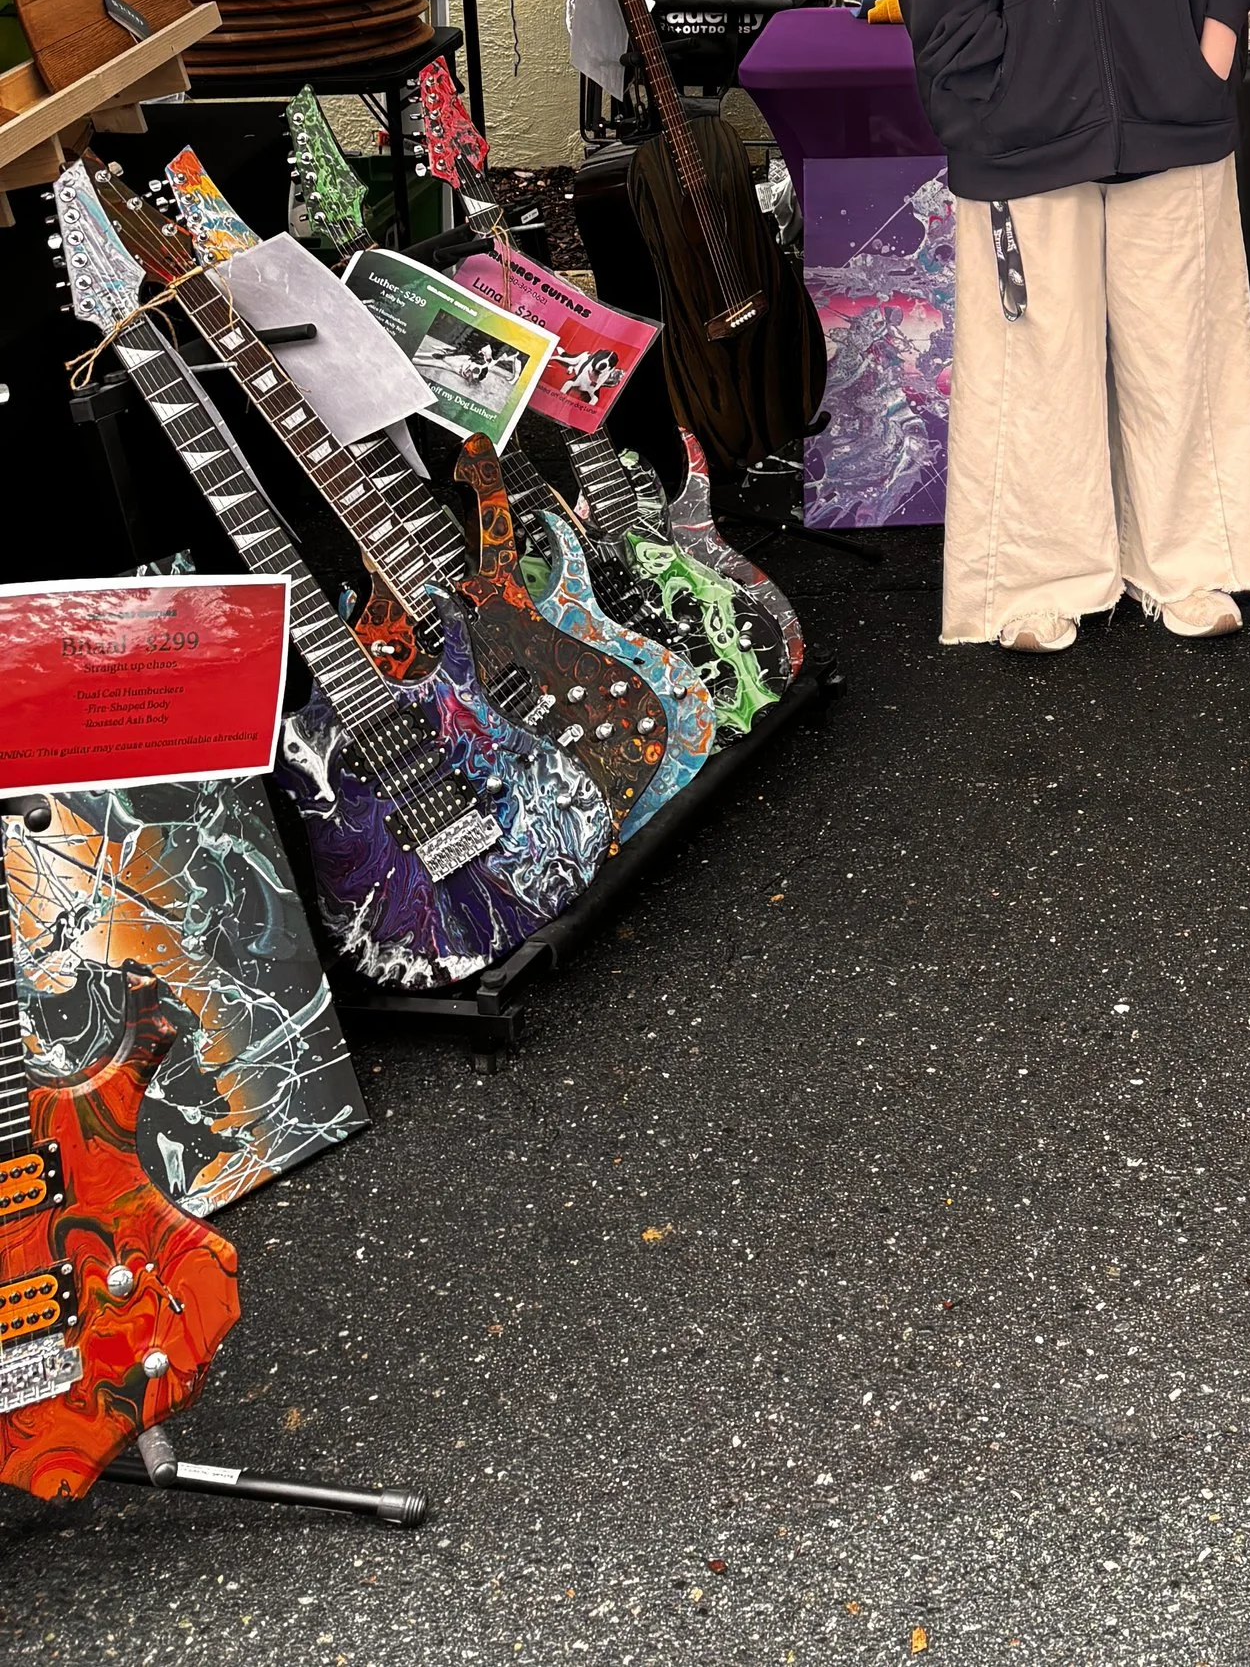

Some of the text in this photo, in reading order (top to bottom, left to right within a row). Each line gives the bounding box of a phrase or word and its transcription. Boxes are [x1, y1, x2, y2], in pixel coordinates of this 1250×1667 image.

[368, 271, 400, 293] Luther
[402, 289, 427, 308] $299
[471, 276, 505, 303] Luna
[506, 275, 550, 305] 80-347-0621
[538, 281, 593, 319] GUITARS
[440, 390, 454, 402] my
[452, 395, 471, 409] Dog
[469, 402, 497, 422] Luther!
[83, 658, 176, 675] Straight up chaos
[101, 687, 121, 697] Coil
[123, 683, 184, 696] Humbuckers
[146, 699, 169, 710] Body
[145, 713, 168, 725] Body
[37, 746, 57, 757] This
[58, 744, 90, 757] guitar
[92, 743, 113, 754] may
[114, 741, 141, 750] cause
[144, 734, 210, 747] uncontrollable
[212, 731, 257, 744] shredding
